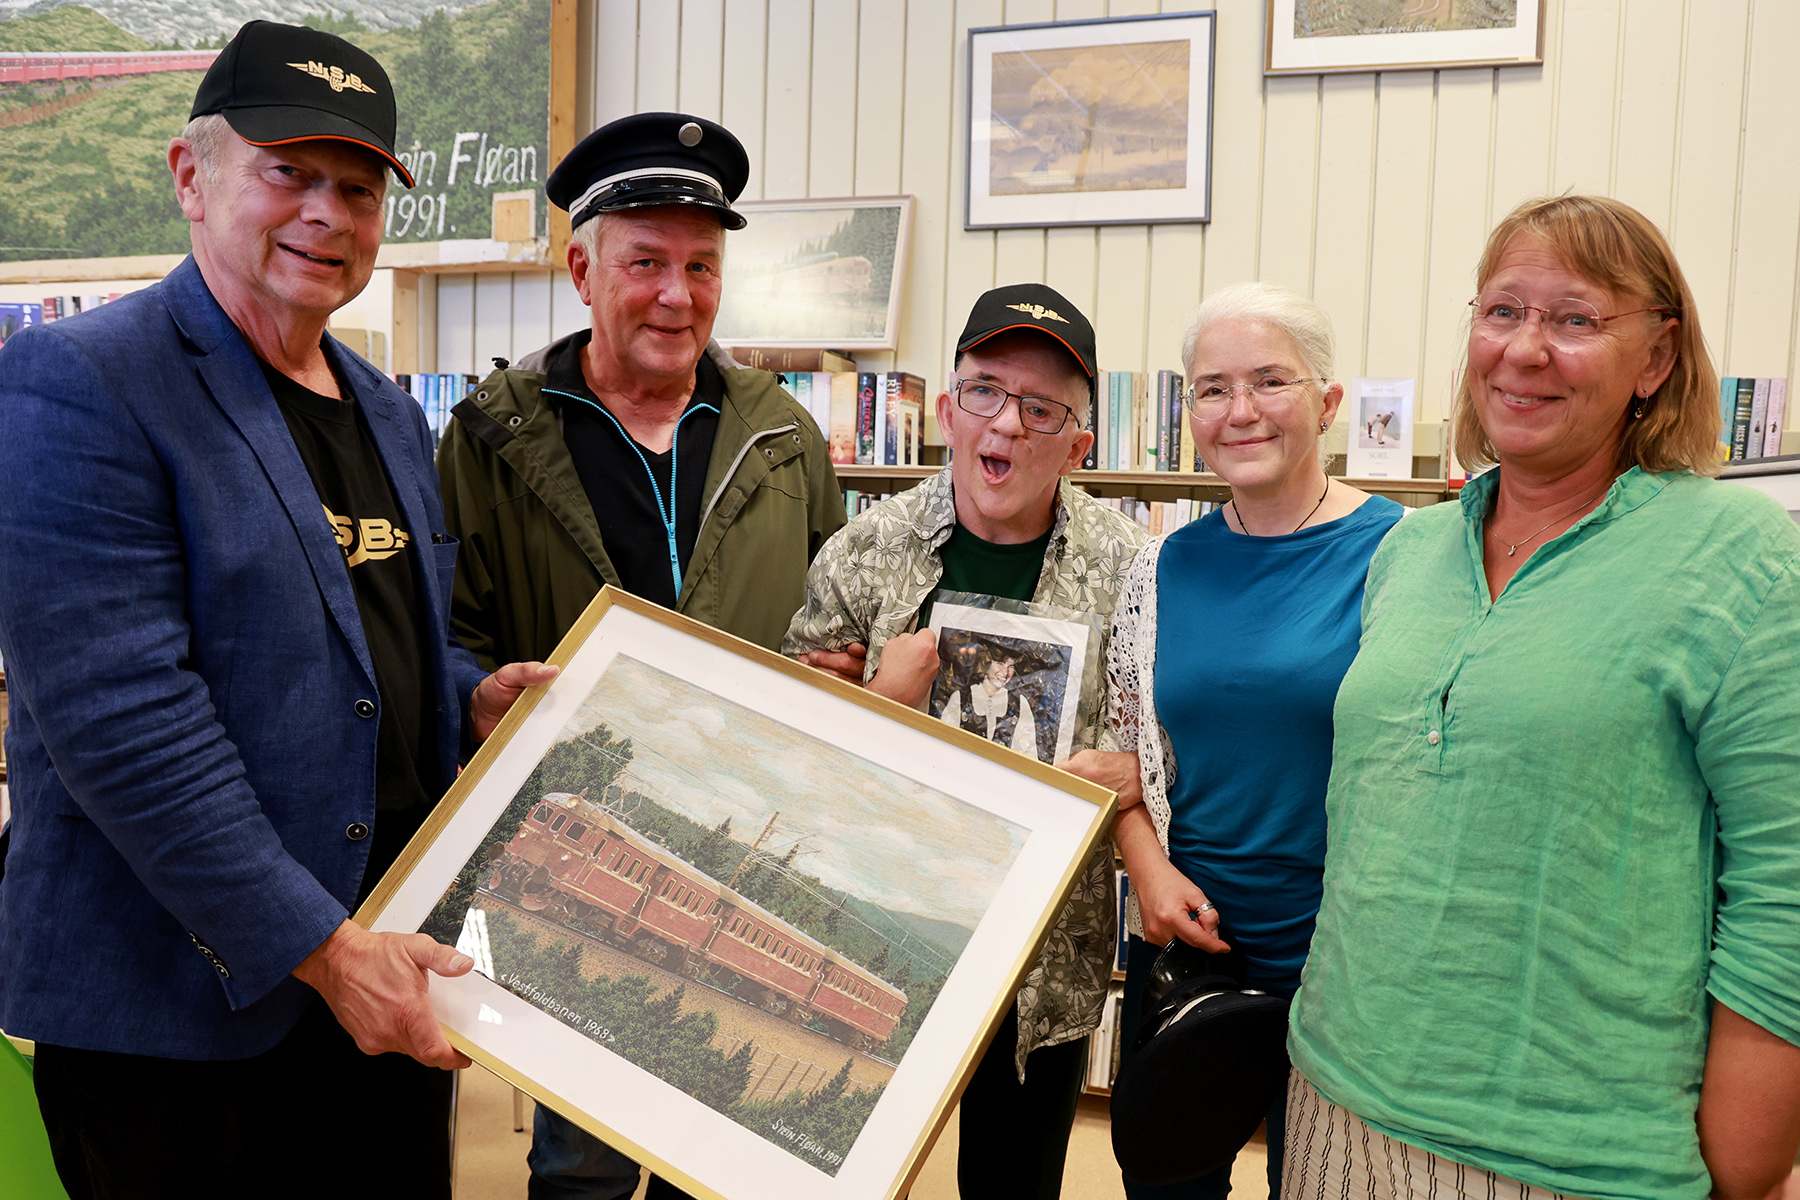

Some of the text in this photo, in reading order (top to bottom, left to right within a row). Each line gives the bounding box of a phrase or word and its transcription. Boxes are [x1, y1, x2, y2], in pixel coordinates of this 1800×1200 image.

[308, 60, 362, 89] NSB
[392, 132, 538, 188] ein Fløan
[1735, 424, 1746, 442] MISS
